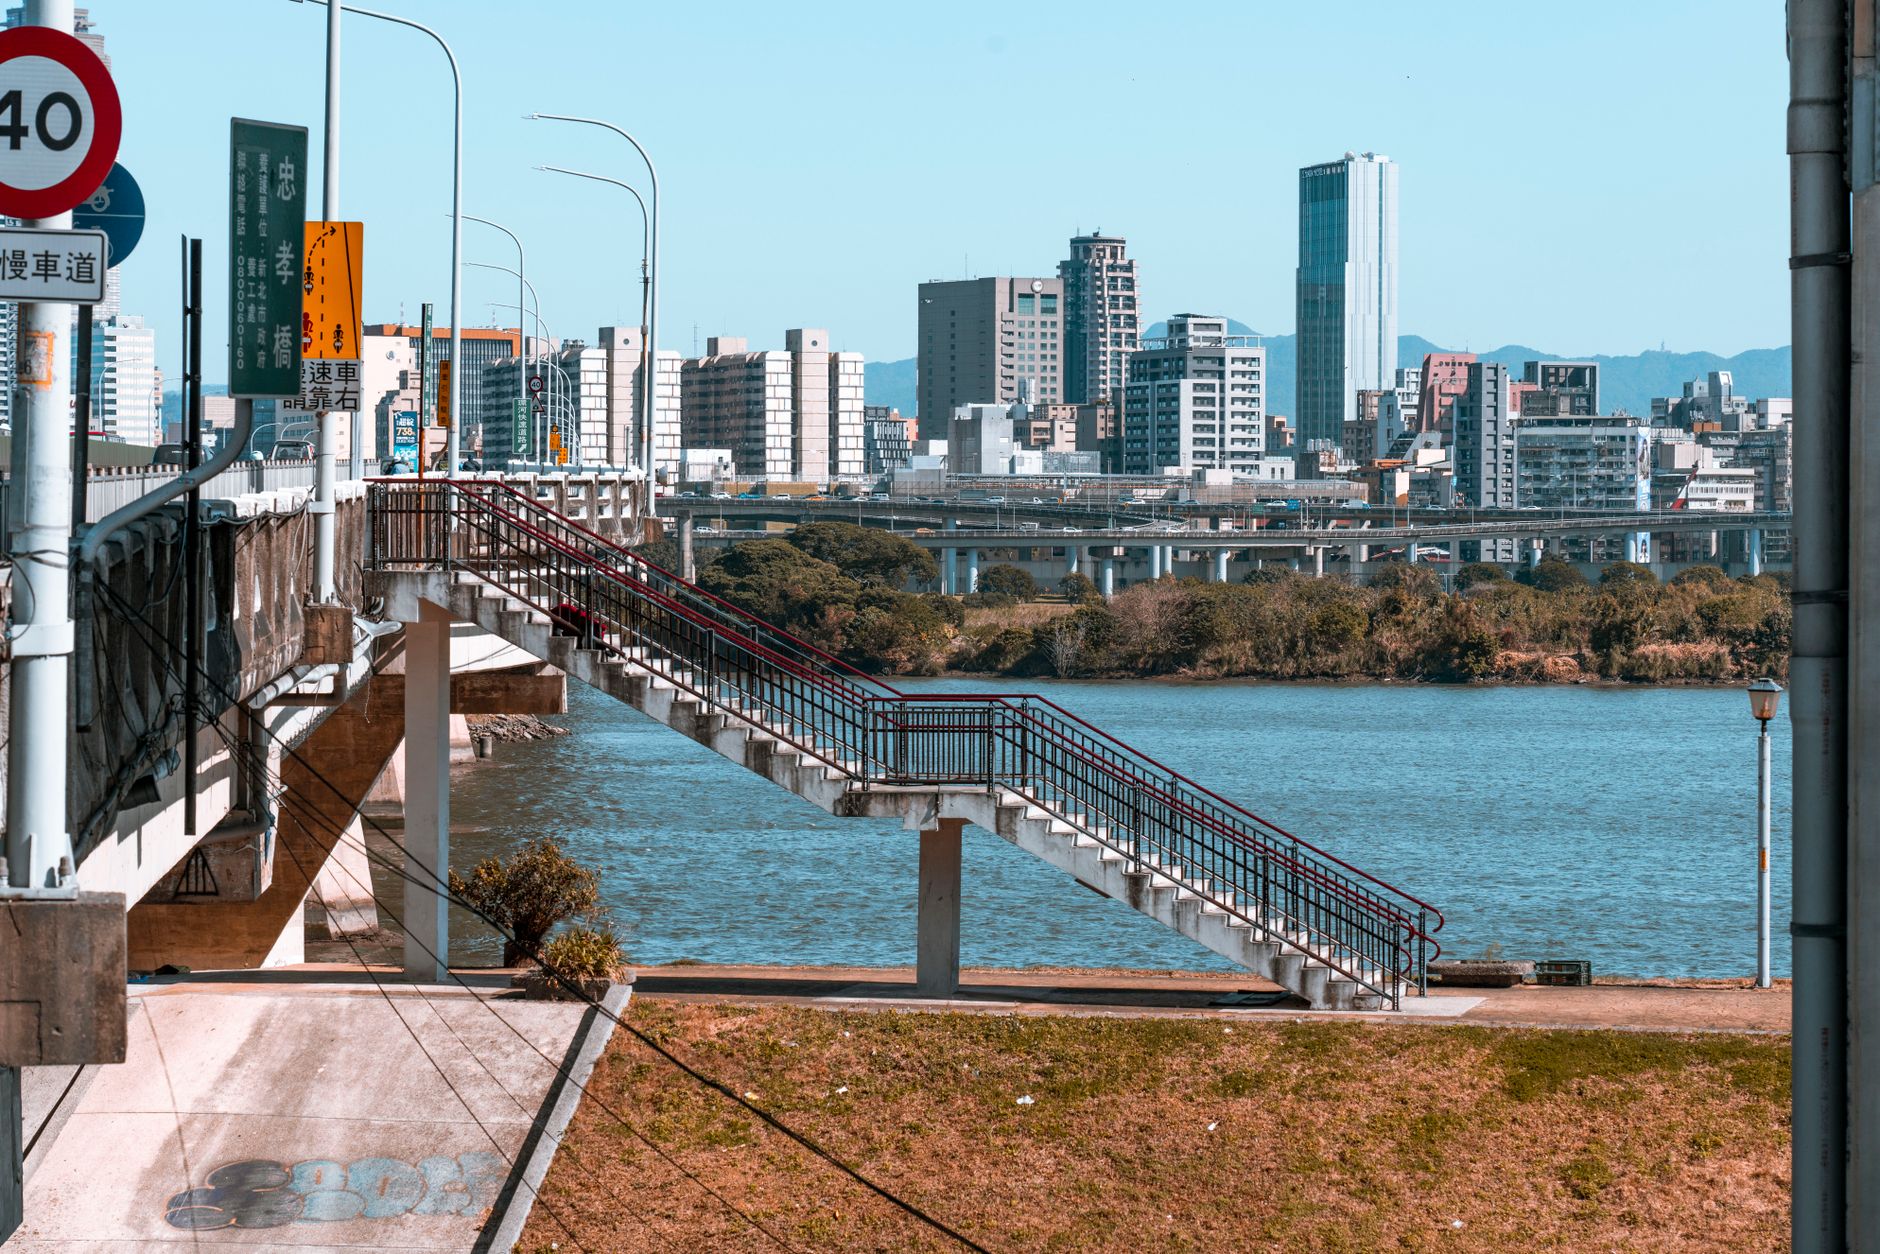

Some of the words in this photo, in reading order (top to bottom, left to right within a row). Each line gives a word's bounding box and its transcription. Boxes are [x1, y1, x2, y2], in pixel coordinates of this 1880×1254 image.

[0, 90, 82, 151] 40
[0, 248, 97, 285] 慢車道
[273, 155, 296, 369] 忠孝橋
[302, 360, 359, 385] 速車
[517, 399, 527, 443] 環河快速道路
